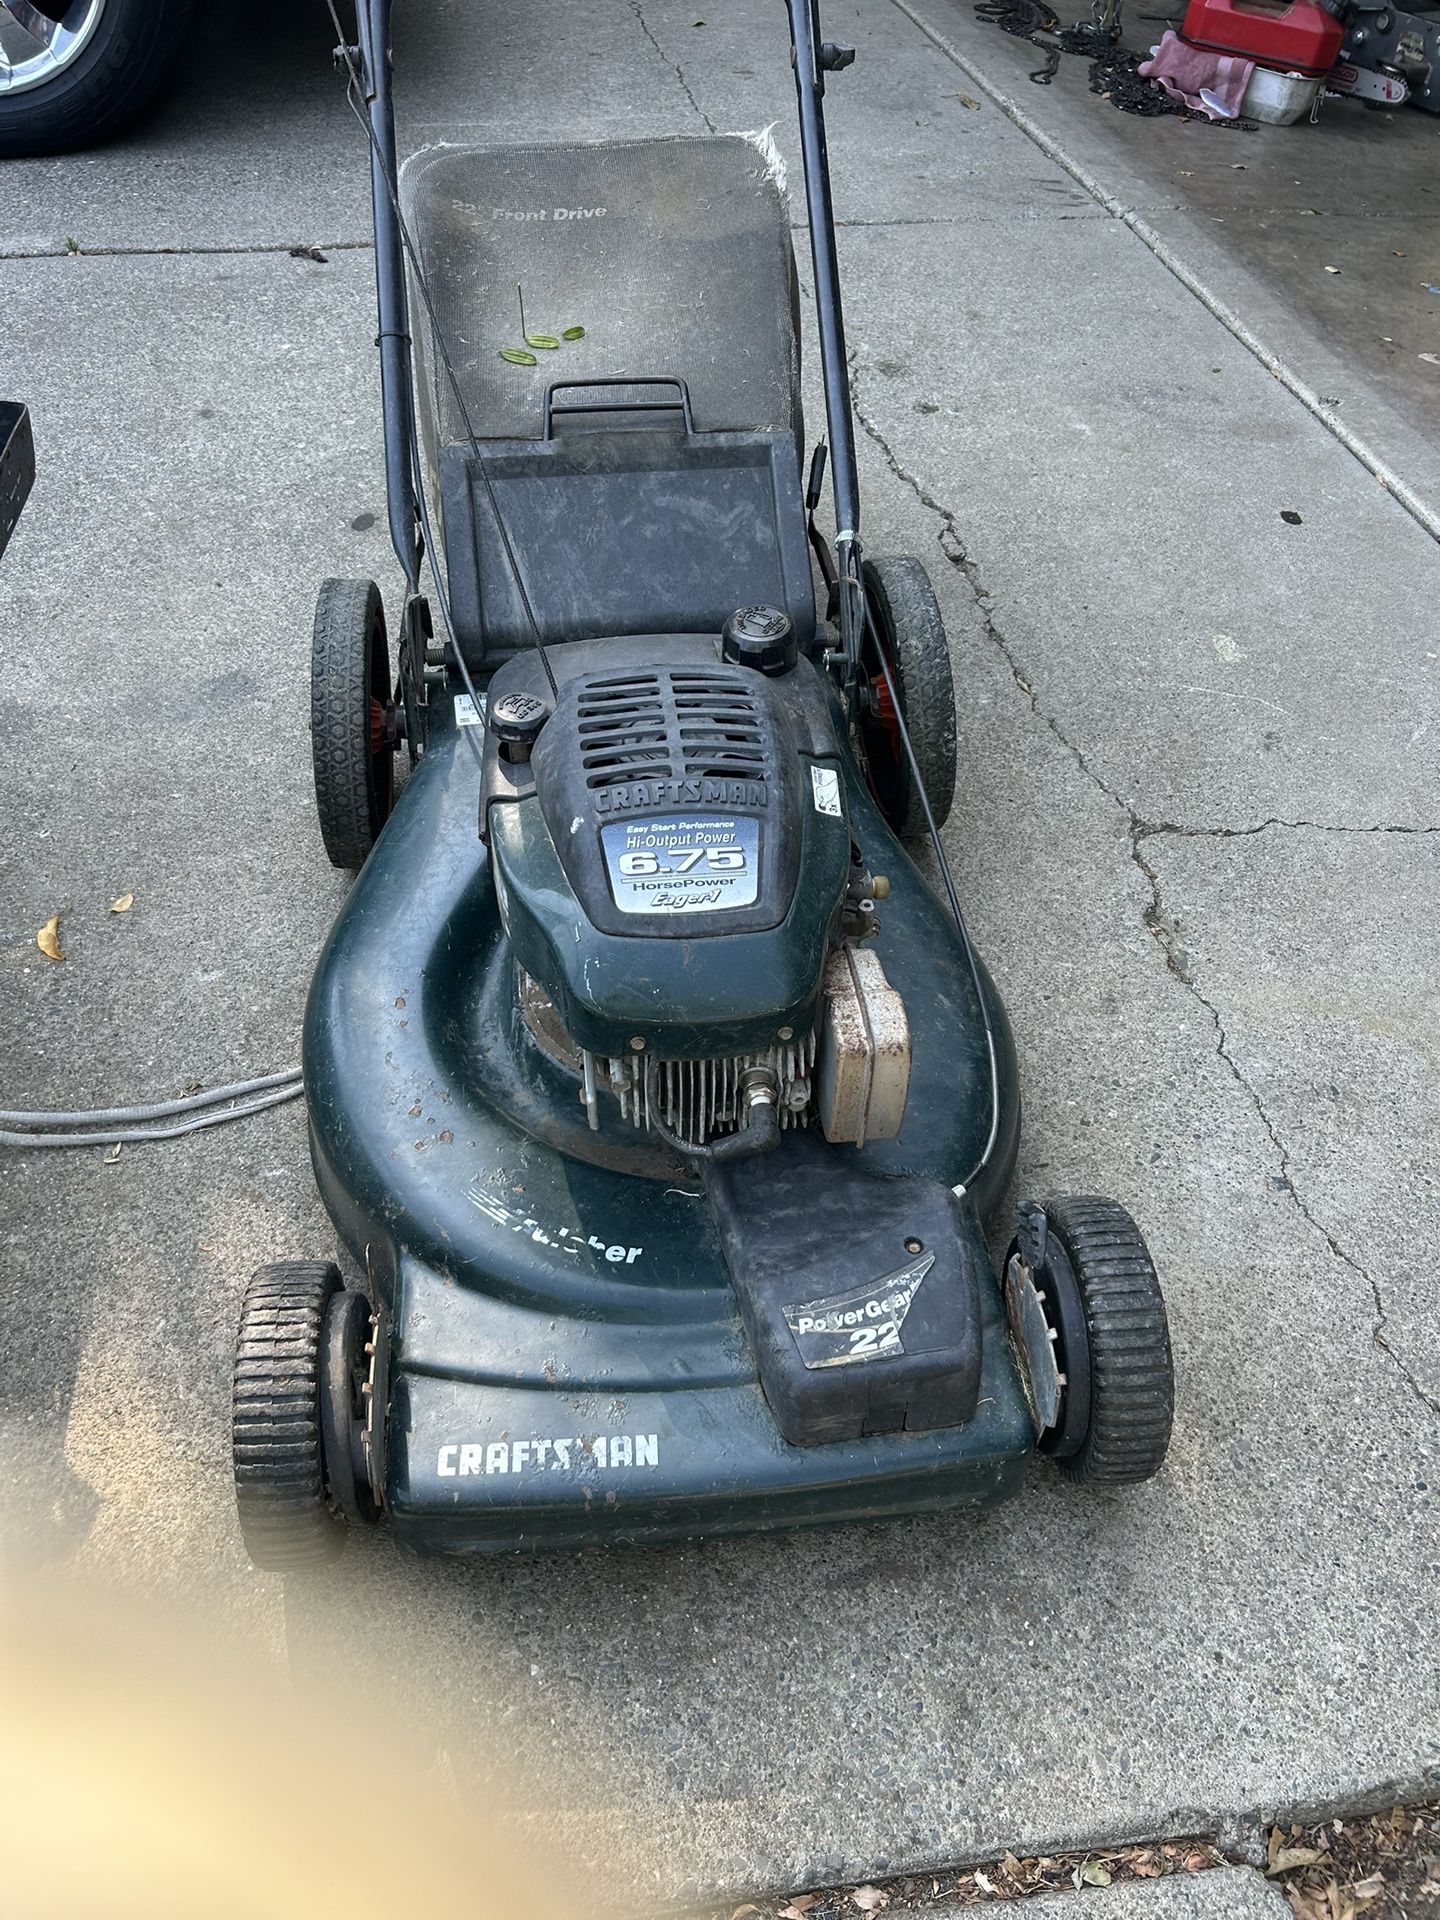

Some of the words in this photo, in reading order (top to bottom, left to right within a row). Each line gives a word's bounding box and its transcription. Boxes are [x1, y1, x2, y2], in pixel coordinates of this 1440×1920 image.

[492, 208, 547, 221] Front
[553, 206, 608, 221] Drive
[594, 780, 769, 813] CRAFTSMAN
[627, 825, 649, 834] Easy
[651, 823, 677, 832] Start
[679, 821, 735, 830] Performance
[627, 833, 692, 849] Hi-Output
[695, 832, 736, 844] Power
[618, 846, 747, 876] 6.75
[632, 877, 737, 892] HorsePower
[849, 1320, 902, 1355] 22
